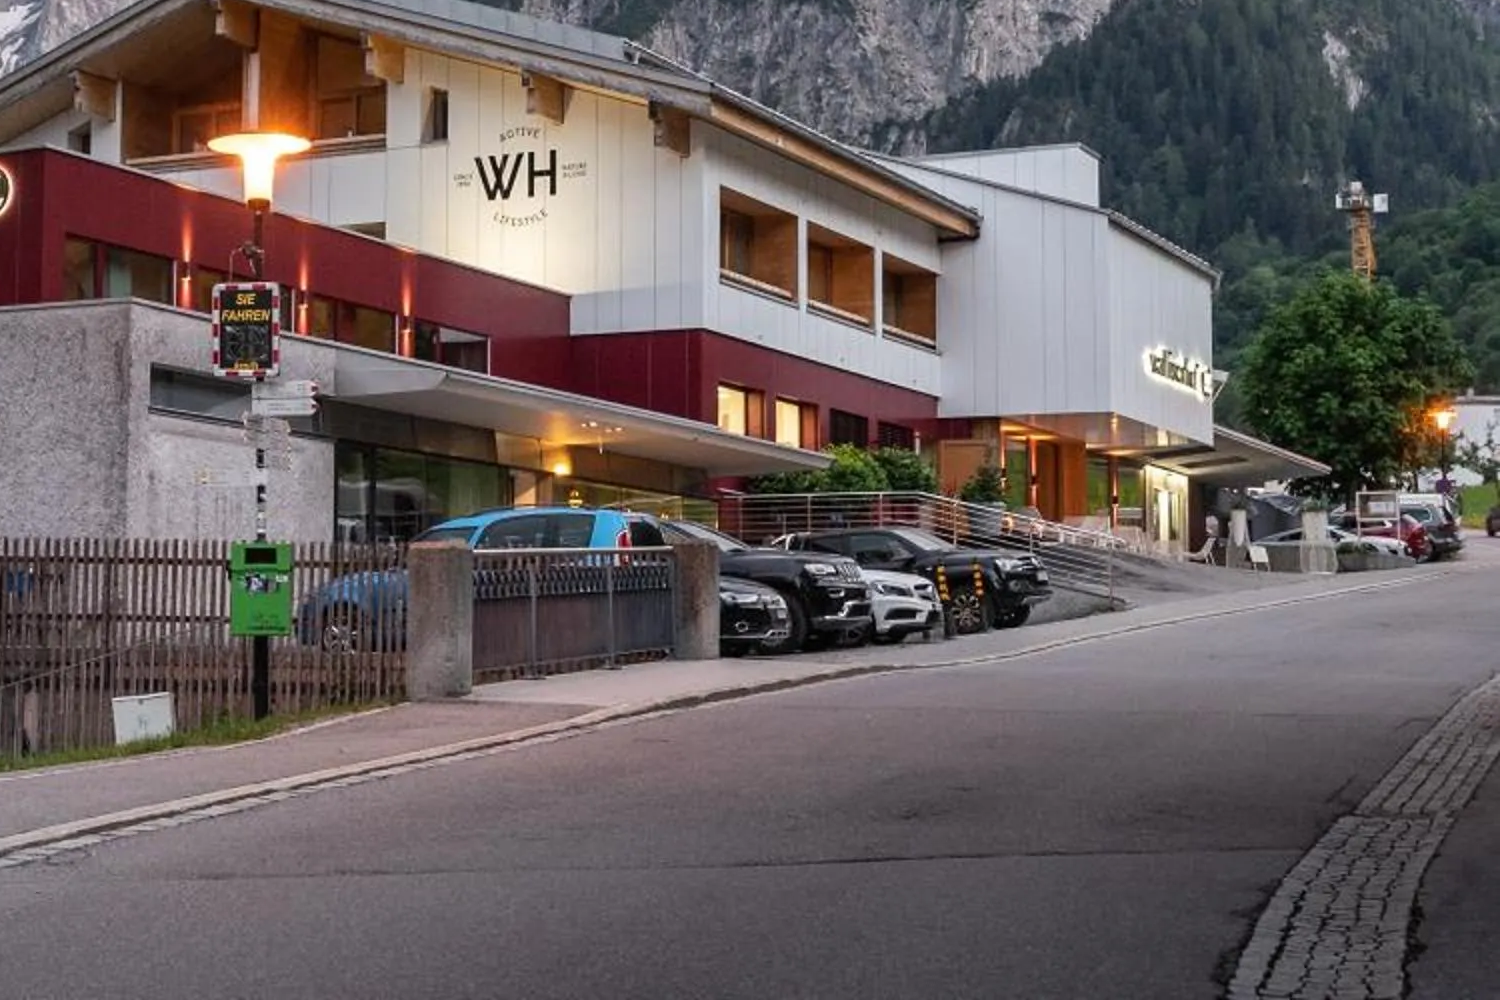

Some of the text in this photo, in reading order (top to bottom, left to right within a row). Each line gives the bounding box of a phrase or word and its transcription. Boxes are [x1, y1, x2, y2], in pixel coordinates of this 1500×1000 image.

[474, 149, 557, 201] WH
[493, 208, 548, 227] LIFESTYLE
[235, 293, 257, 306] SIE
[221, 309, 271, 322] FAHREN
